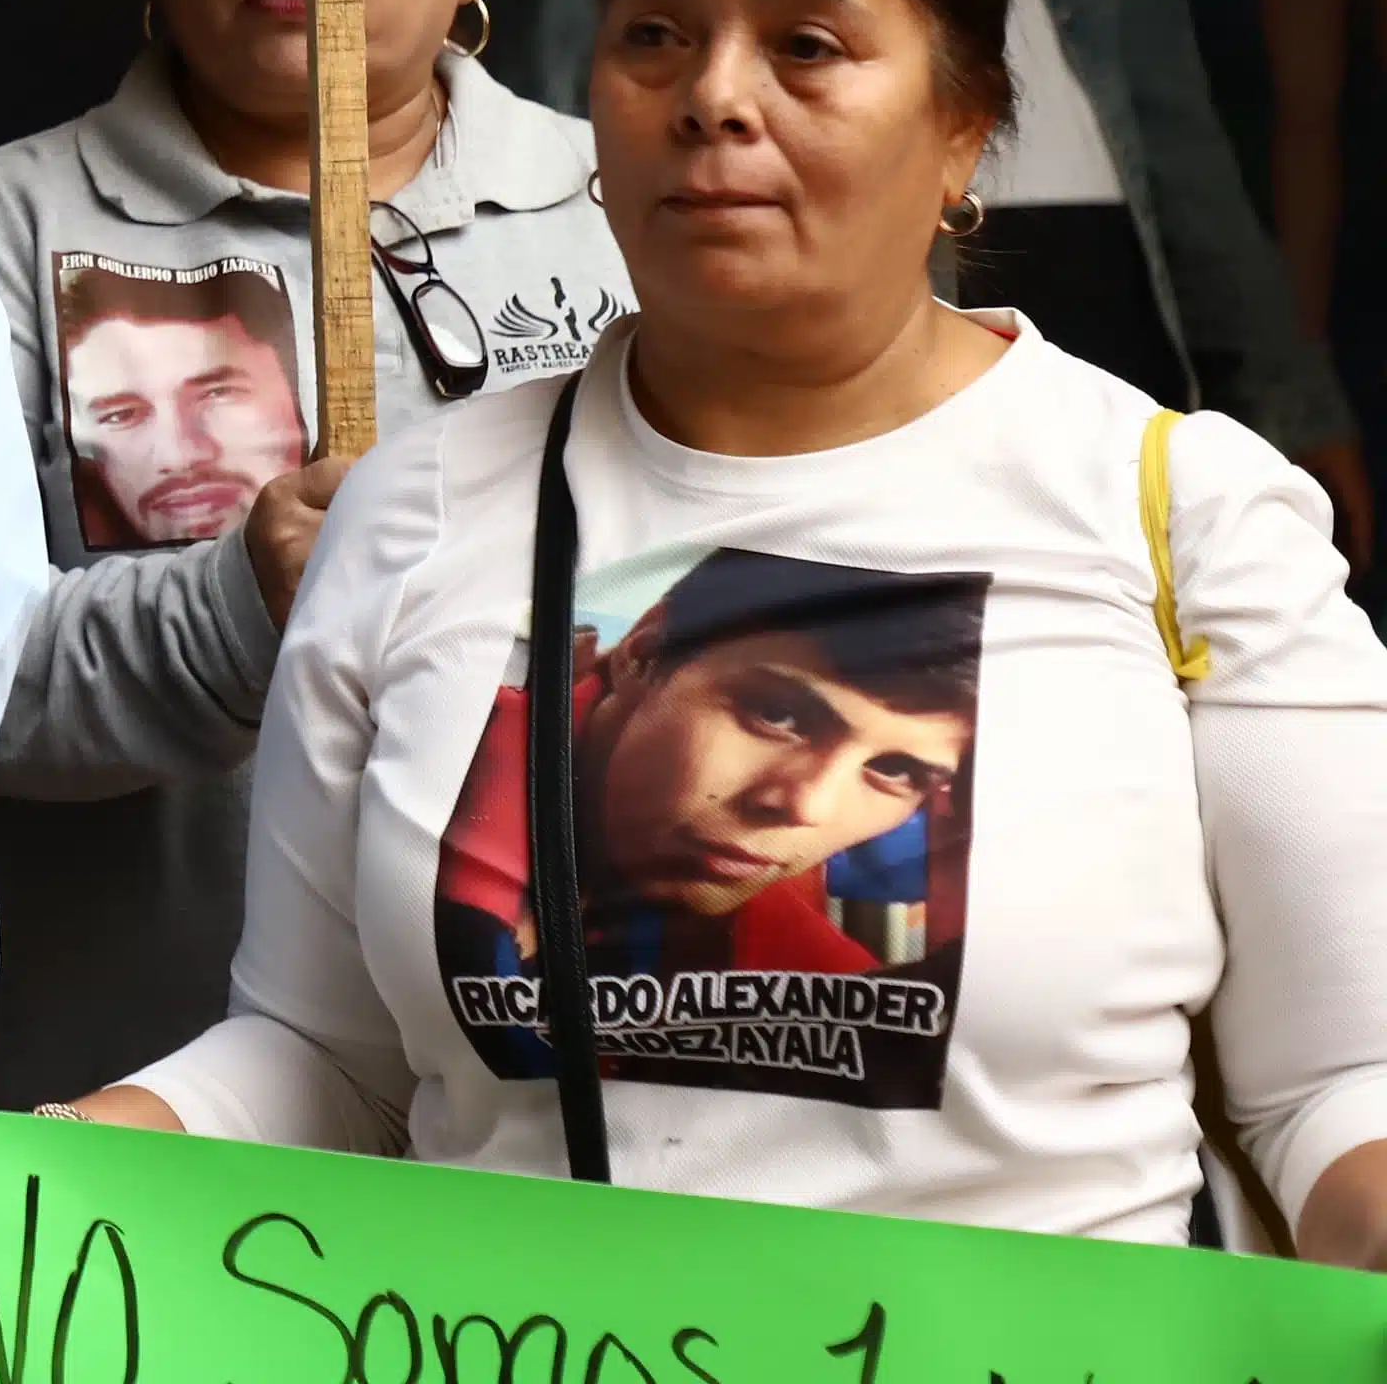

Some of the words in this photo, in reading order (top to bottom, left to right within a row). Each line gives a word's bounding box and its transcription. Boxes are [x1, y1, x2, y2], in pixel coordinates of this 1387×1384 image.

[62, 254, 94, 269] ERNI
[97, 256, 172, 282] GUILLERMO
[176, 263, 218, 284] RUBIO
[493, 342, 594, 365] RASTREA
[453, 974, 664, 1028] RICDO
[665, 971, 943, 1037] ALEXANDER
[535, 1022, 731, 1064] NDEZ
[731, 1027, 866, 1079] AYALA
